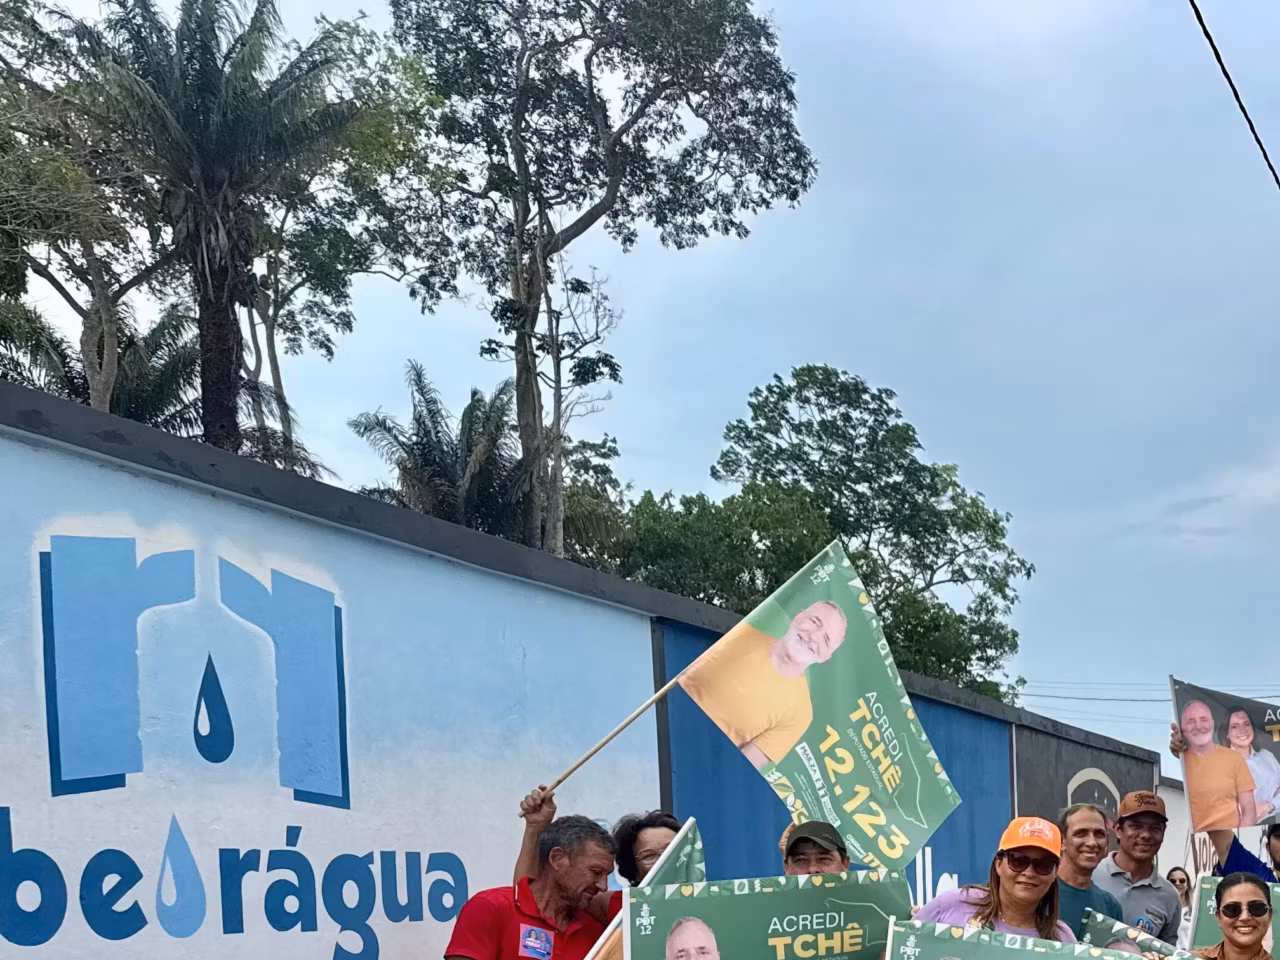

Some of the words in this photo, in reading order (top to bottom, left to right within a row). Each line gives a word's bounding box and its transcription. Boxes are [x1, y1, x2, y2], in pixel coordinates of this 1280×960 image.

[866, 692, 902, 761] ACREDI
[849, 699, 902, 793] TCHÊ
[819, 724, 910, 859] 12.123
[636, 916, 656, 926] PDT
[640, 926, 652, 935] 12
[768, 912, 844, 933] ACREDI
[768, 923, 863, 960] TCHÊ
[900, 947, 921, 957] PDT
